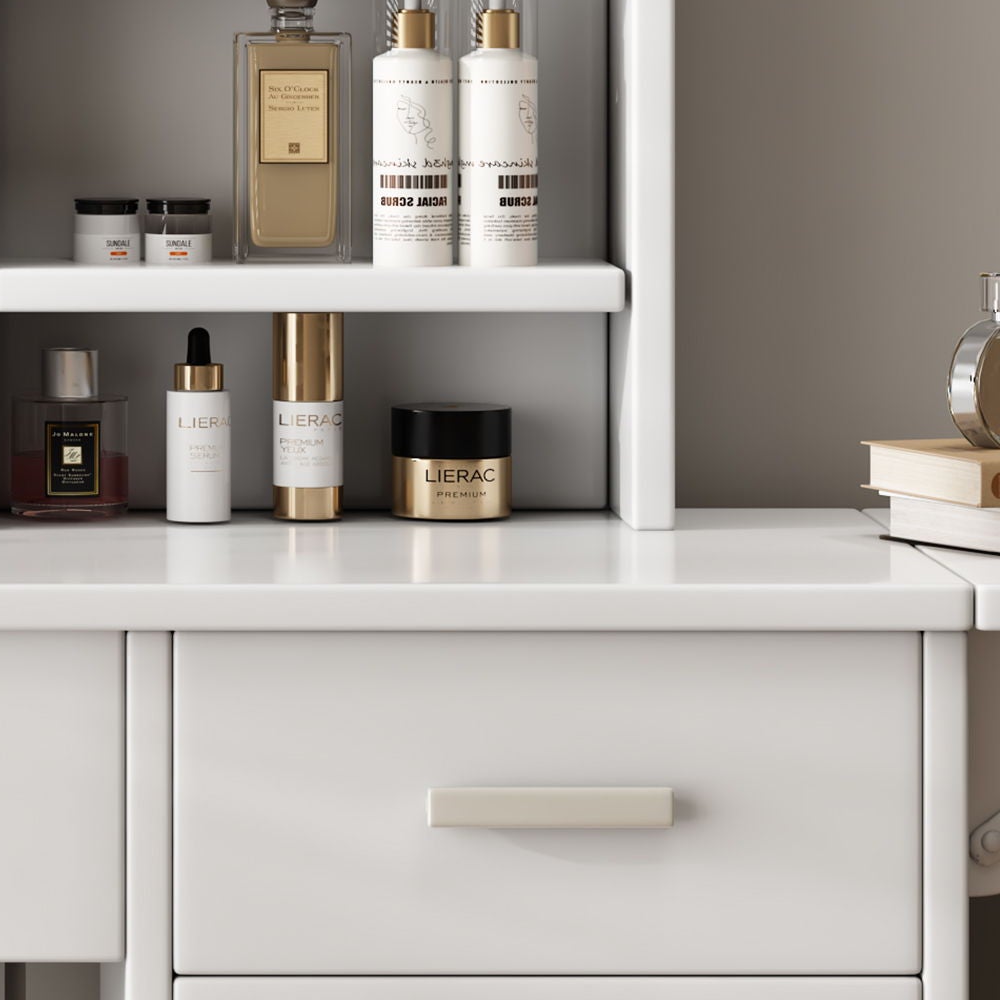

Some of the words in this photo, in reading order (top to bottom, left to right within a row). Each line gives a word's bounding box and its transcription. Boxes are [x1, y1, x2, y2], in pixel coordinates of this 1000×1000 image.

[279, 413, 342, 427] LIERAC
[425, 468, 496, 483] LIERAC
[436, 491, 487, 499] PREMIUM
